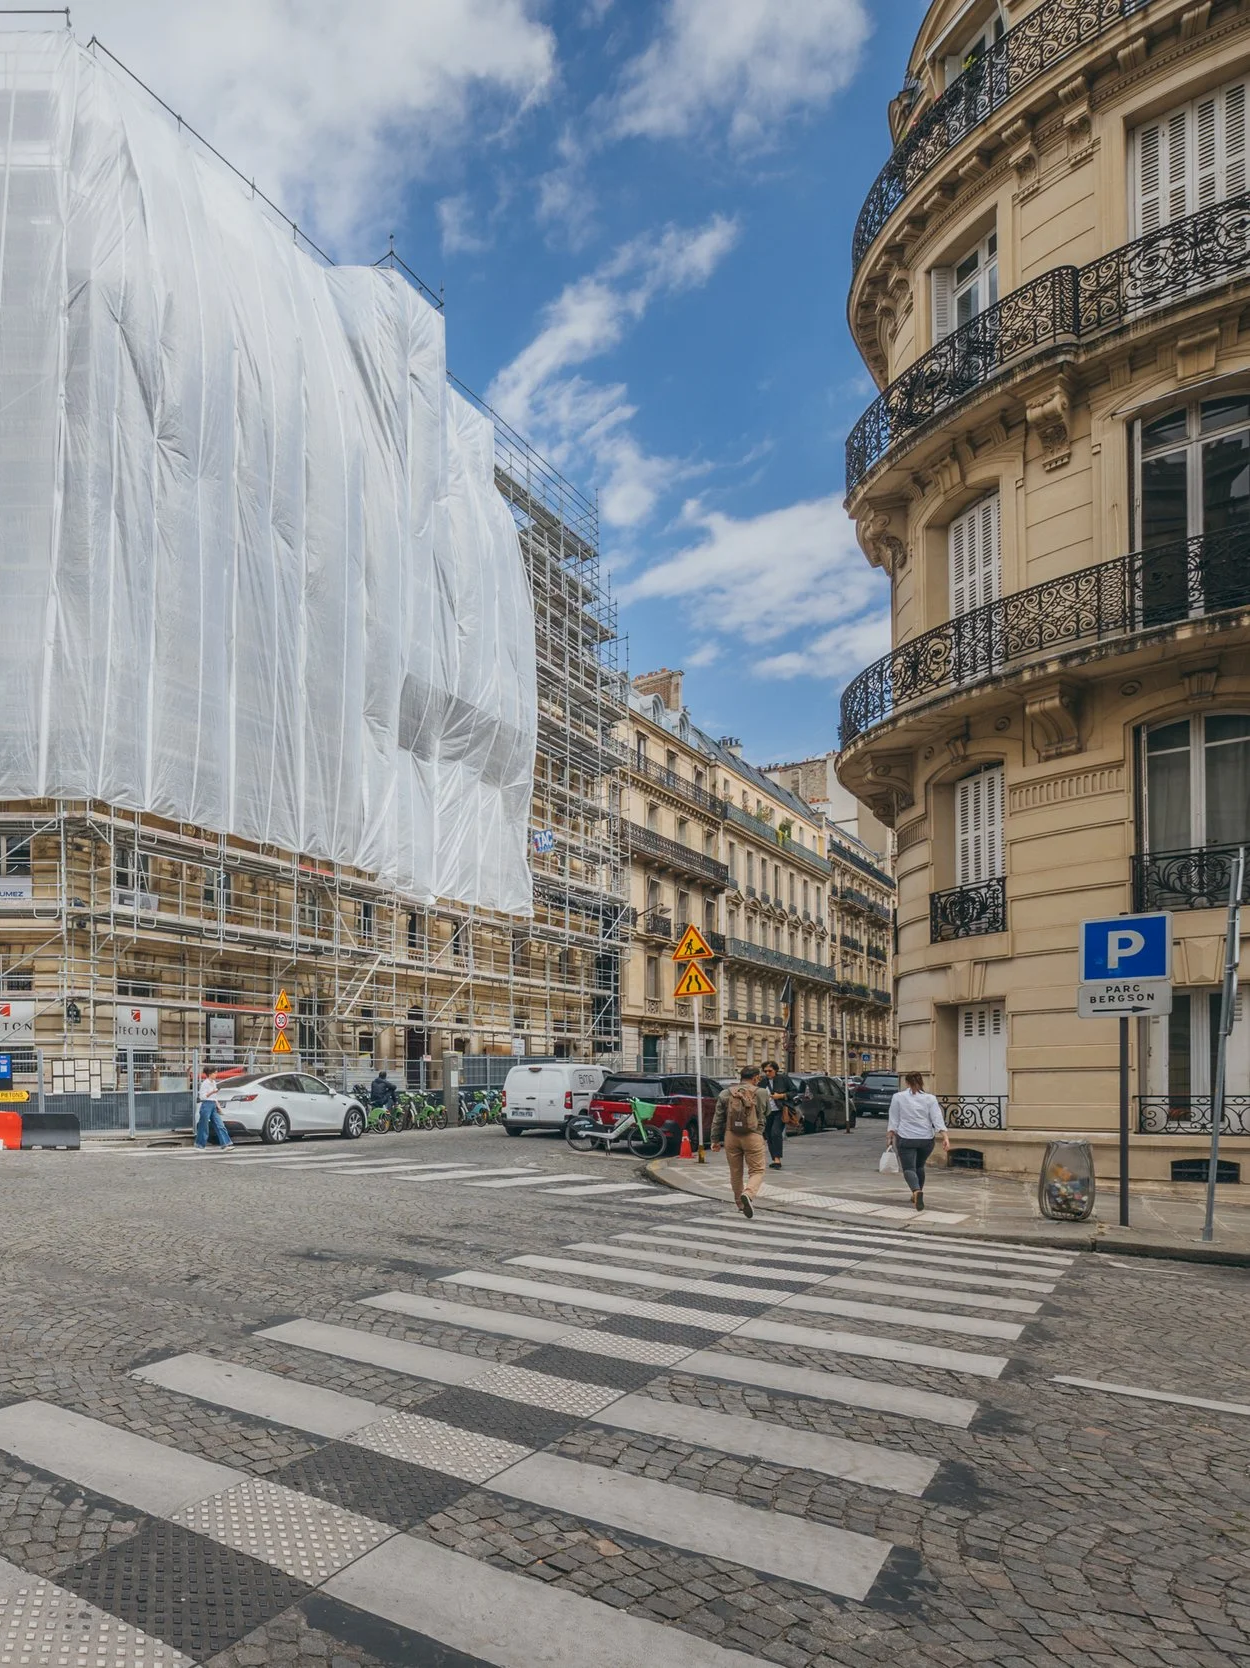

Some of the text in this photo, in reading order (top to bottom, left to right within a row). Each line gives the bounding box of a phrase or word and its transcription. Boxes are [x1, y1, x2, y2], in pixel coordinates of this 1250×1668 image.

[1107, 930, 1145, 969] P
[1106, 985, 1140, 993] PARC
[1090, 993, 1155, 1003] BERGSON
[118, 1026, 157, 1036] TECTON
